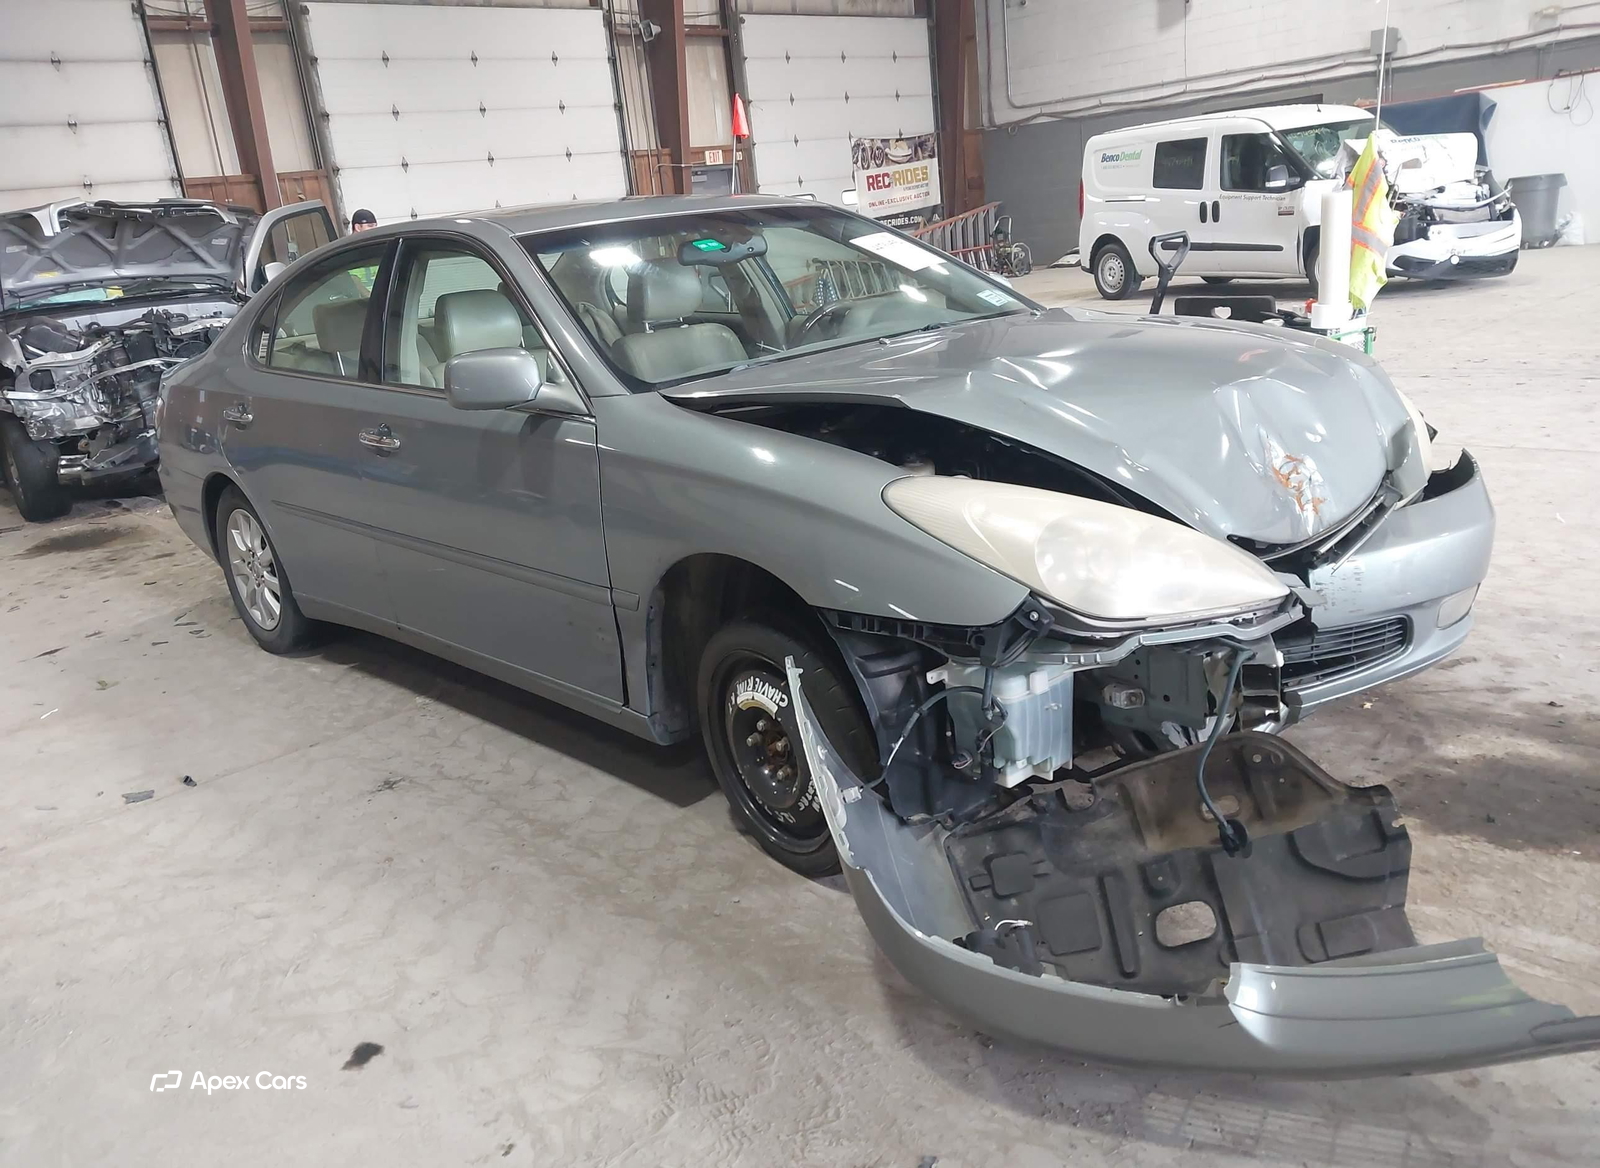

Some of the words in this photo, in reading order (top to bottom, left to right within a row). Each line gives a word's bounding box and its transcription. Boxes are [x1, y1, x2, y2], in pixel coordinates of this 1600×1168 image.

[709, 151, 720, 163] EXIT
[866, 172, 891, 192] REC
[893, 166, 928, 186] RIDES
